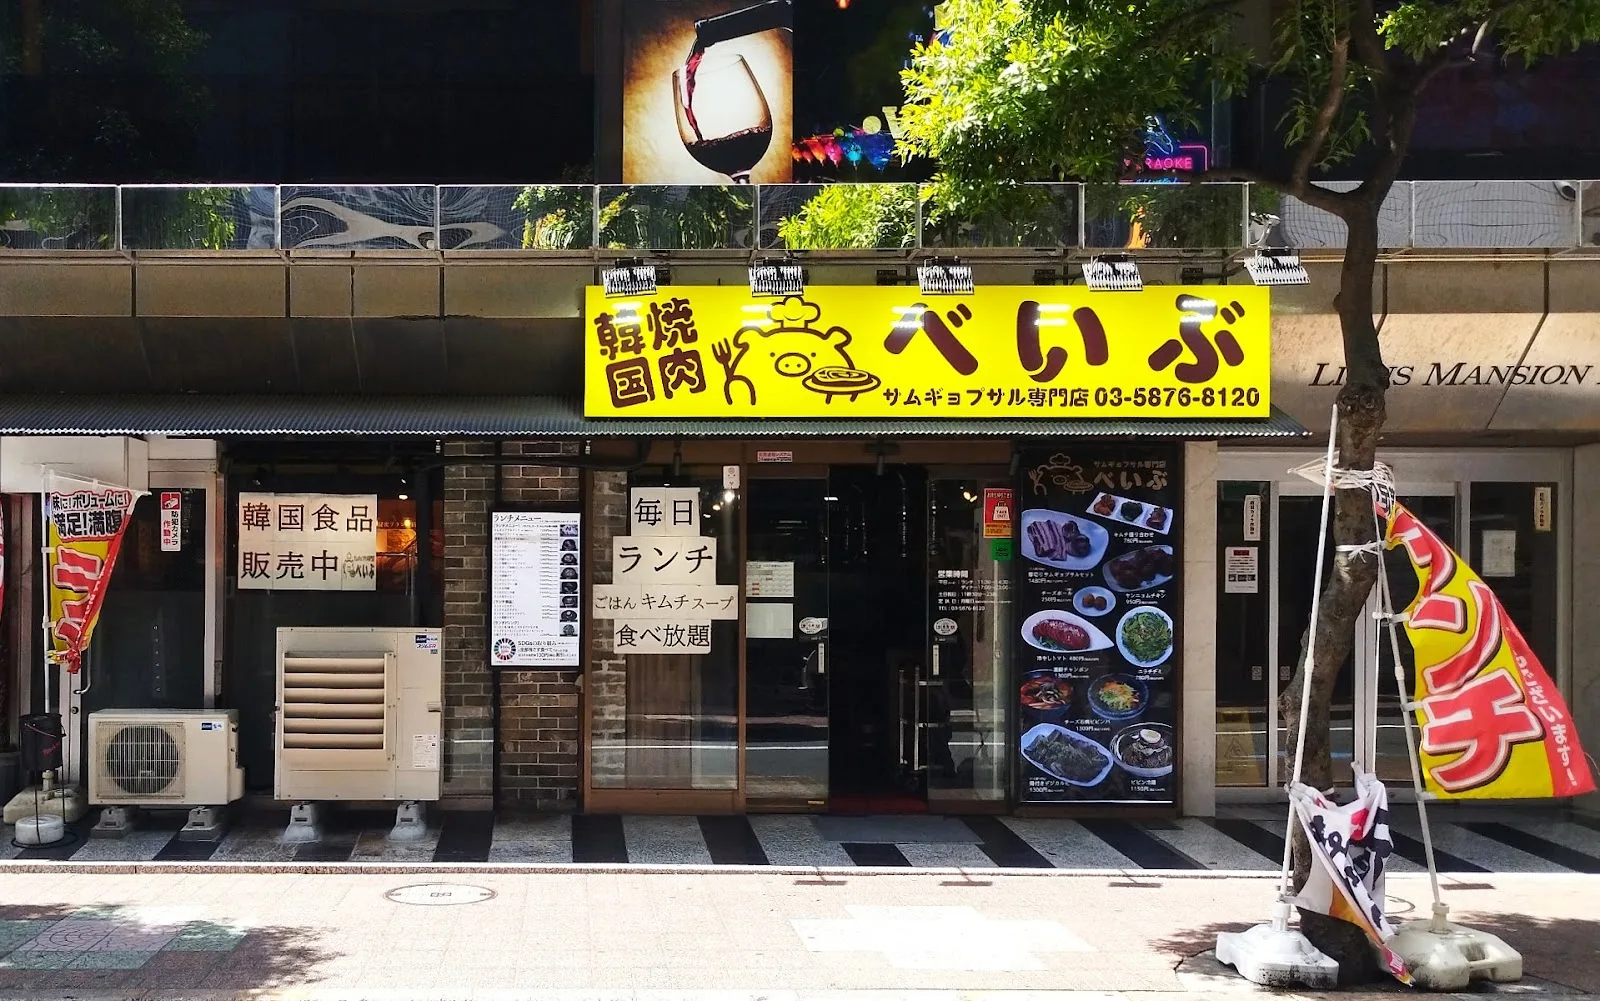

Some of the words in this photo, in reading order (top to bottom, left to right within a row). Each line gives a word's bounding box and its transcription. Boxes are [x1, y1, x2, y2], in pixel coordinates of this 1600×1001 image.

[646, 297, 706, 400] 焼肉
[884, 293, 1245, 383] べいぶ
[594, 309, 655, 408] 韓国
[1422, 363, 1593, 386] MANSION
[883, 387, 1089, 407] サムギョプサル専門店
[1094, 387, 1260, 407] 03-5876-8120
[1093, 470, 1168, 491] べいぶ
[242, 502, 373, 531] 韓国食品
[493, 514, 542, 523] ランチメニュー
[634, 497, 693, 526] 毎日
[240, 549, 339, 580] 販売中
[619, 545, 713, 574] ランチ
[595, 596, 637, 610] ごはん
[615, 624, 710, 647] 食べ放題
